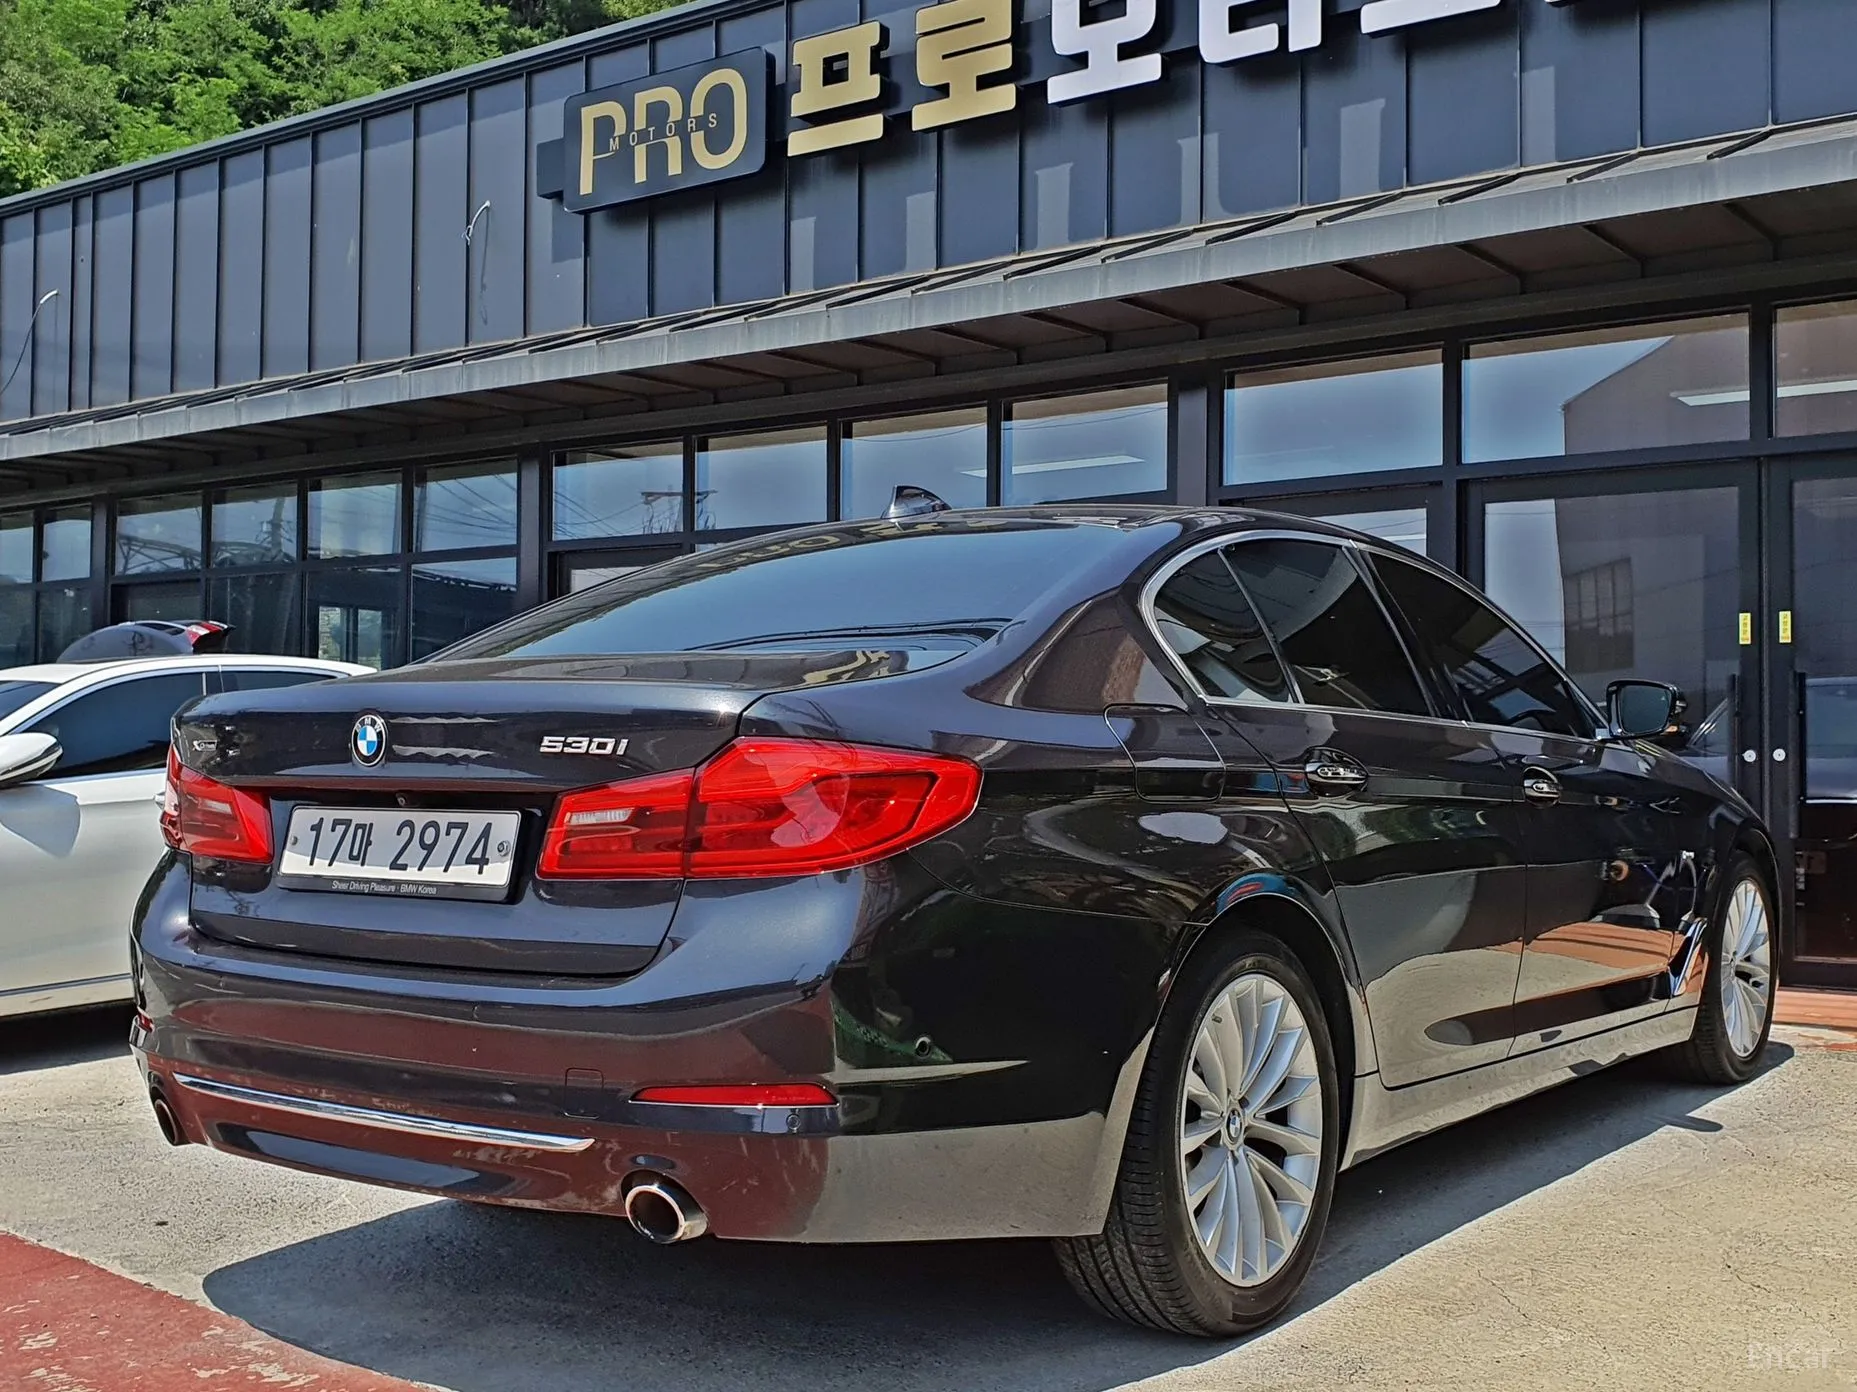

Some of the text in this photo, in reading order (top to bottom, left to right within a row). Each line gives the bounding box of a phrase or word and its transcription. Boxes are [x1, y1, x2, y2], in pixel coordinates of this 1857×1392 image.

[579, 68, 748, 196] PRO
[609, 112, 717, 152] MOTORS
[309, 817, 493, 875] 17마 2974
[331, 880, 437, 895] Sheer Driving Pleasure BMW Korea
